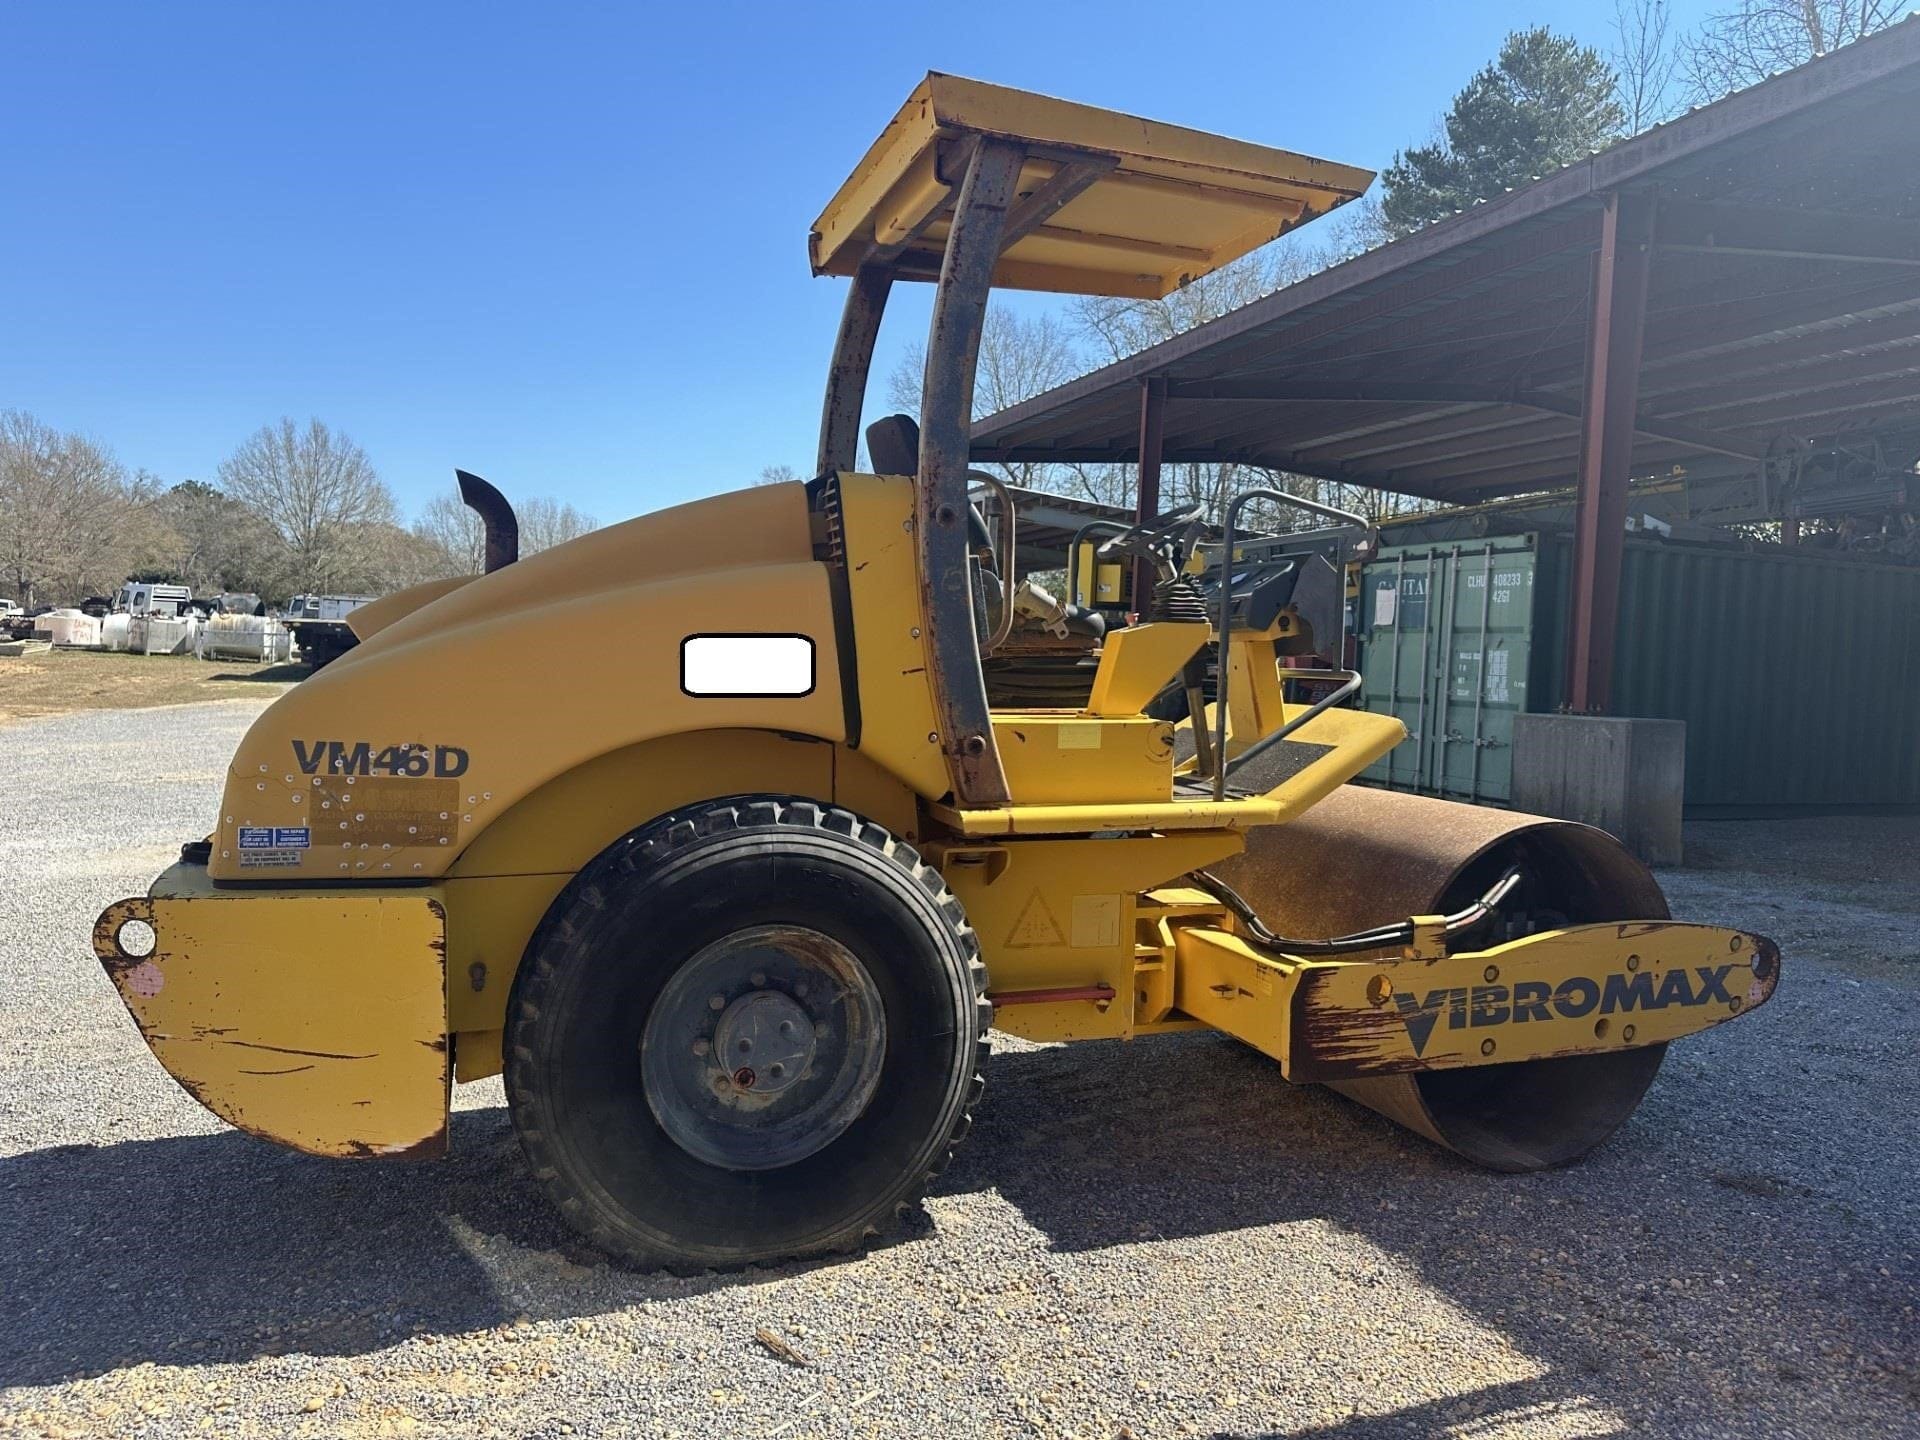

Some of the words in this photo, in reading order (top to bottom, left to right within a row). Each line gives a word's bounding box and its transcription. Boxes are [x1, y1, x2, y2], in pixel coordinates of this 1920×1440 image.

[1492, 572, 1521, 587] 408233
[291, 740, 470, 778] VM46D
[1391, 963, 1734, 1058] VIBROMAX
